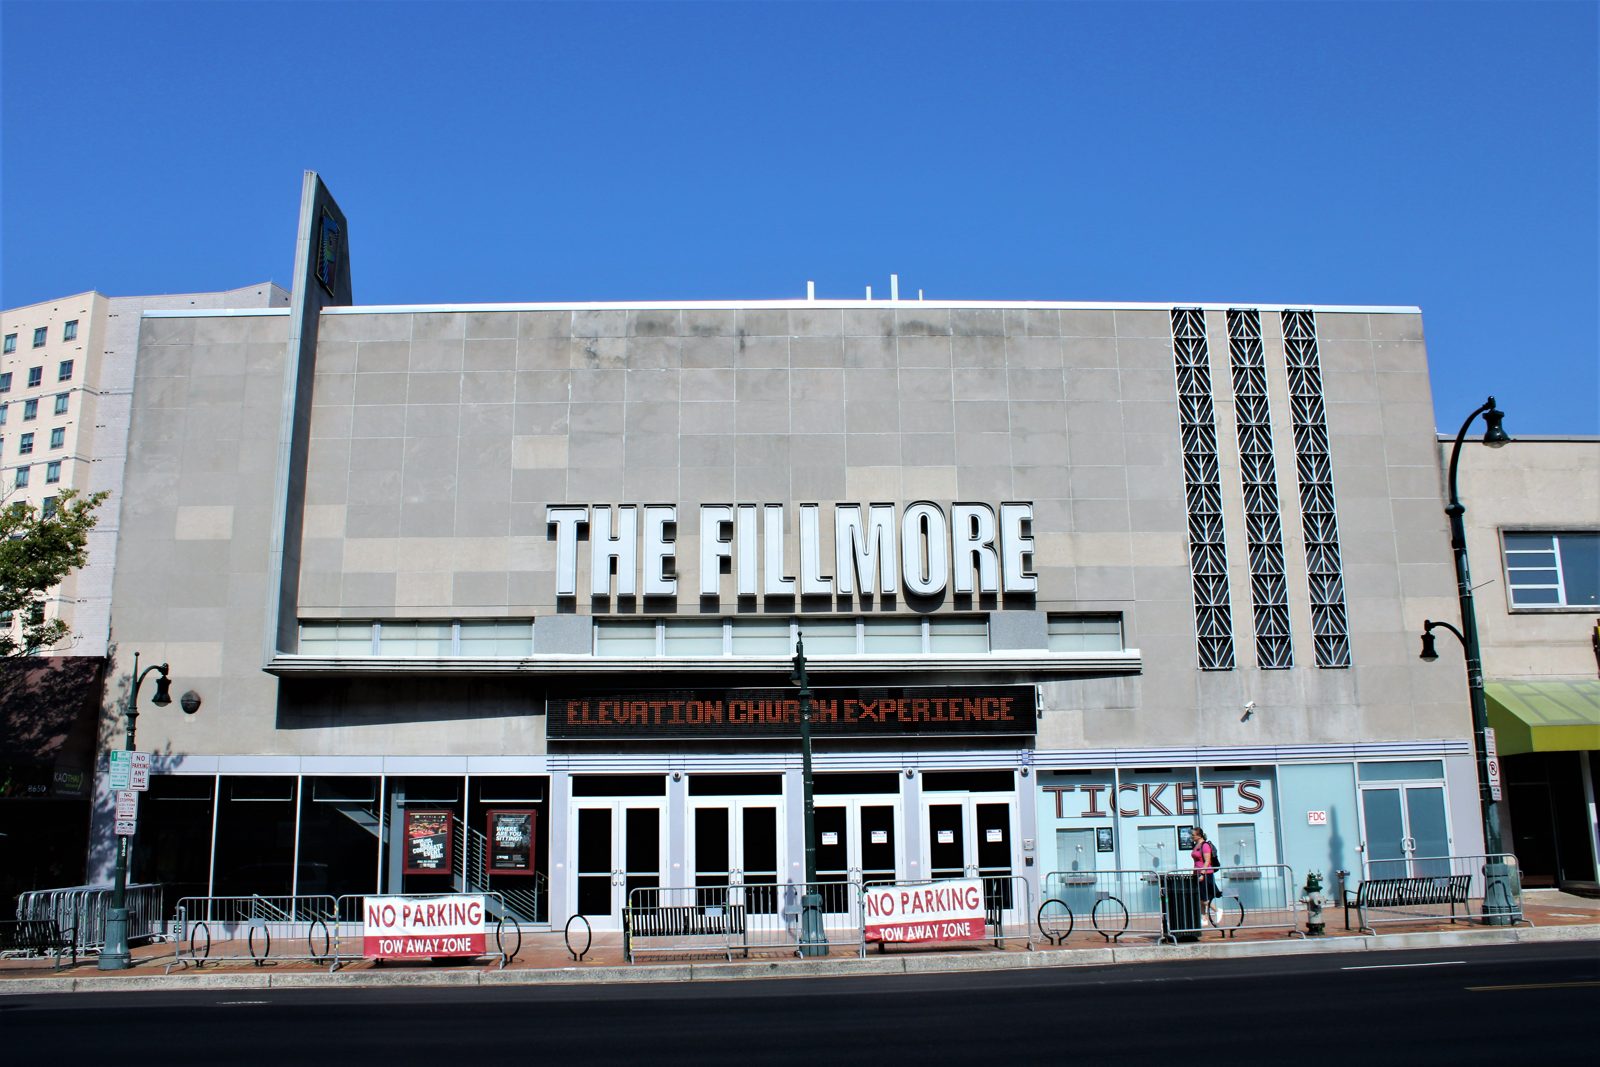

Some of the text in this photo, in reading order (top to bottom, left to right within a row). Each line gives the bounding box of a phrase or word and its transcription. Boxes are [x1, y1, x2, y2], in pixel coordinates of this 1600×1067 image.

[546, 500, 1038, 597] THE FILLMORE
[566, 700, 723, 725] ELEVATION
[844, 697, 1015, 722] EXPERIENCE
[1042, 779, 1265, 818] TICKETS
[1308, 811, 1325, 821] FDC
[368, 902, 481, 928] NO PARKING
[867, 886, 980, 917] NO PARKING
[880, 921, 971, 941] TOW AWAY ZONE
[378, 937, 471, 954] TOW AWAY ZONE
